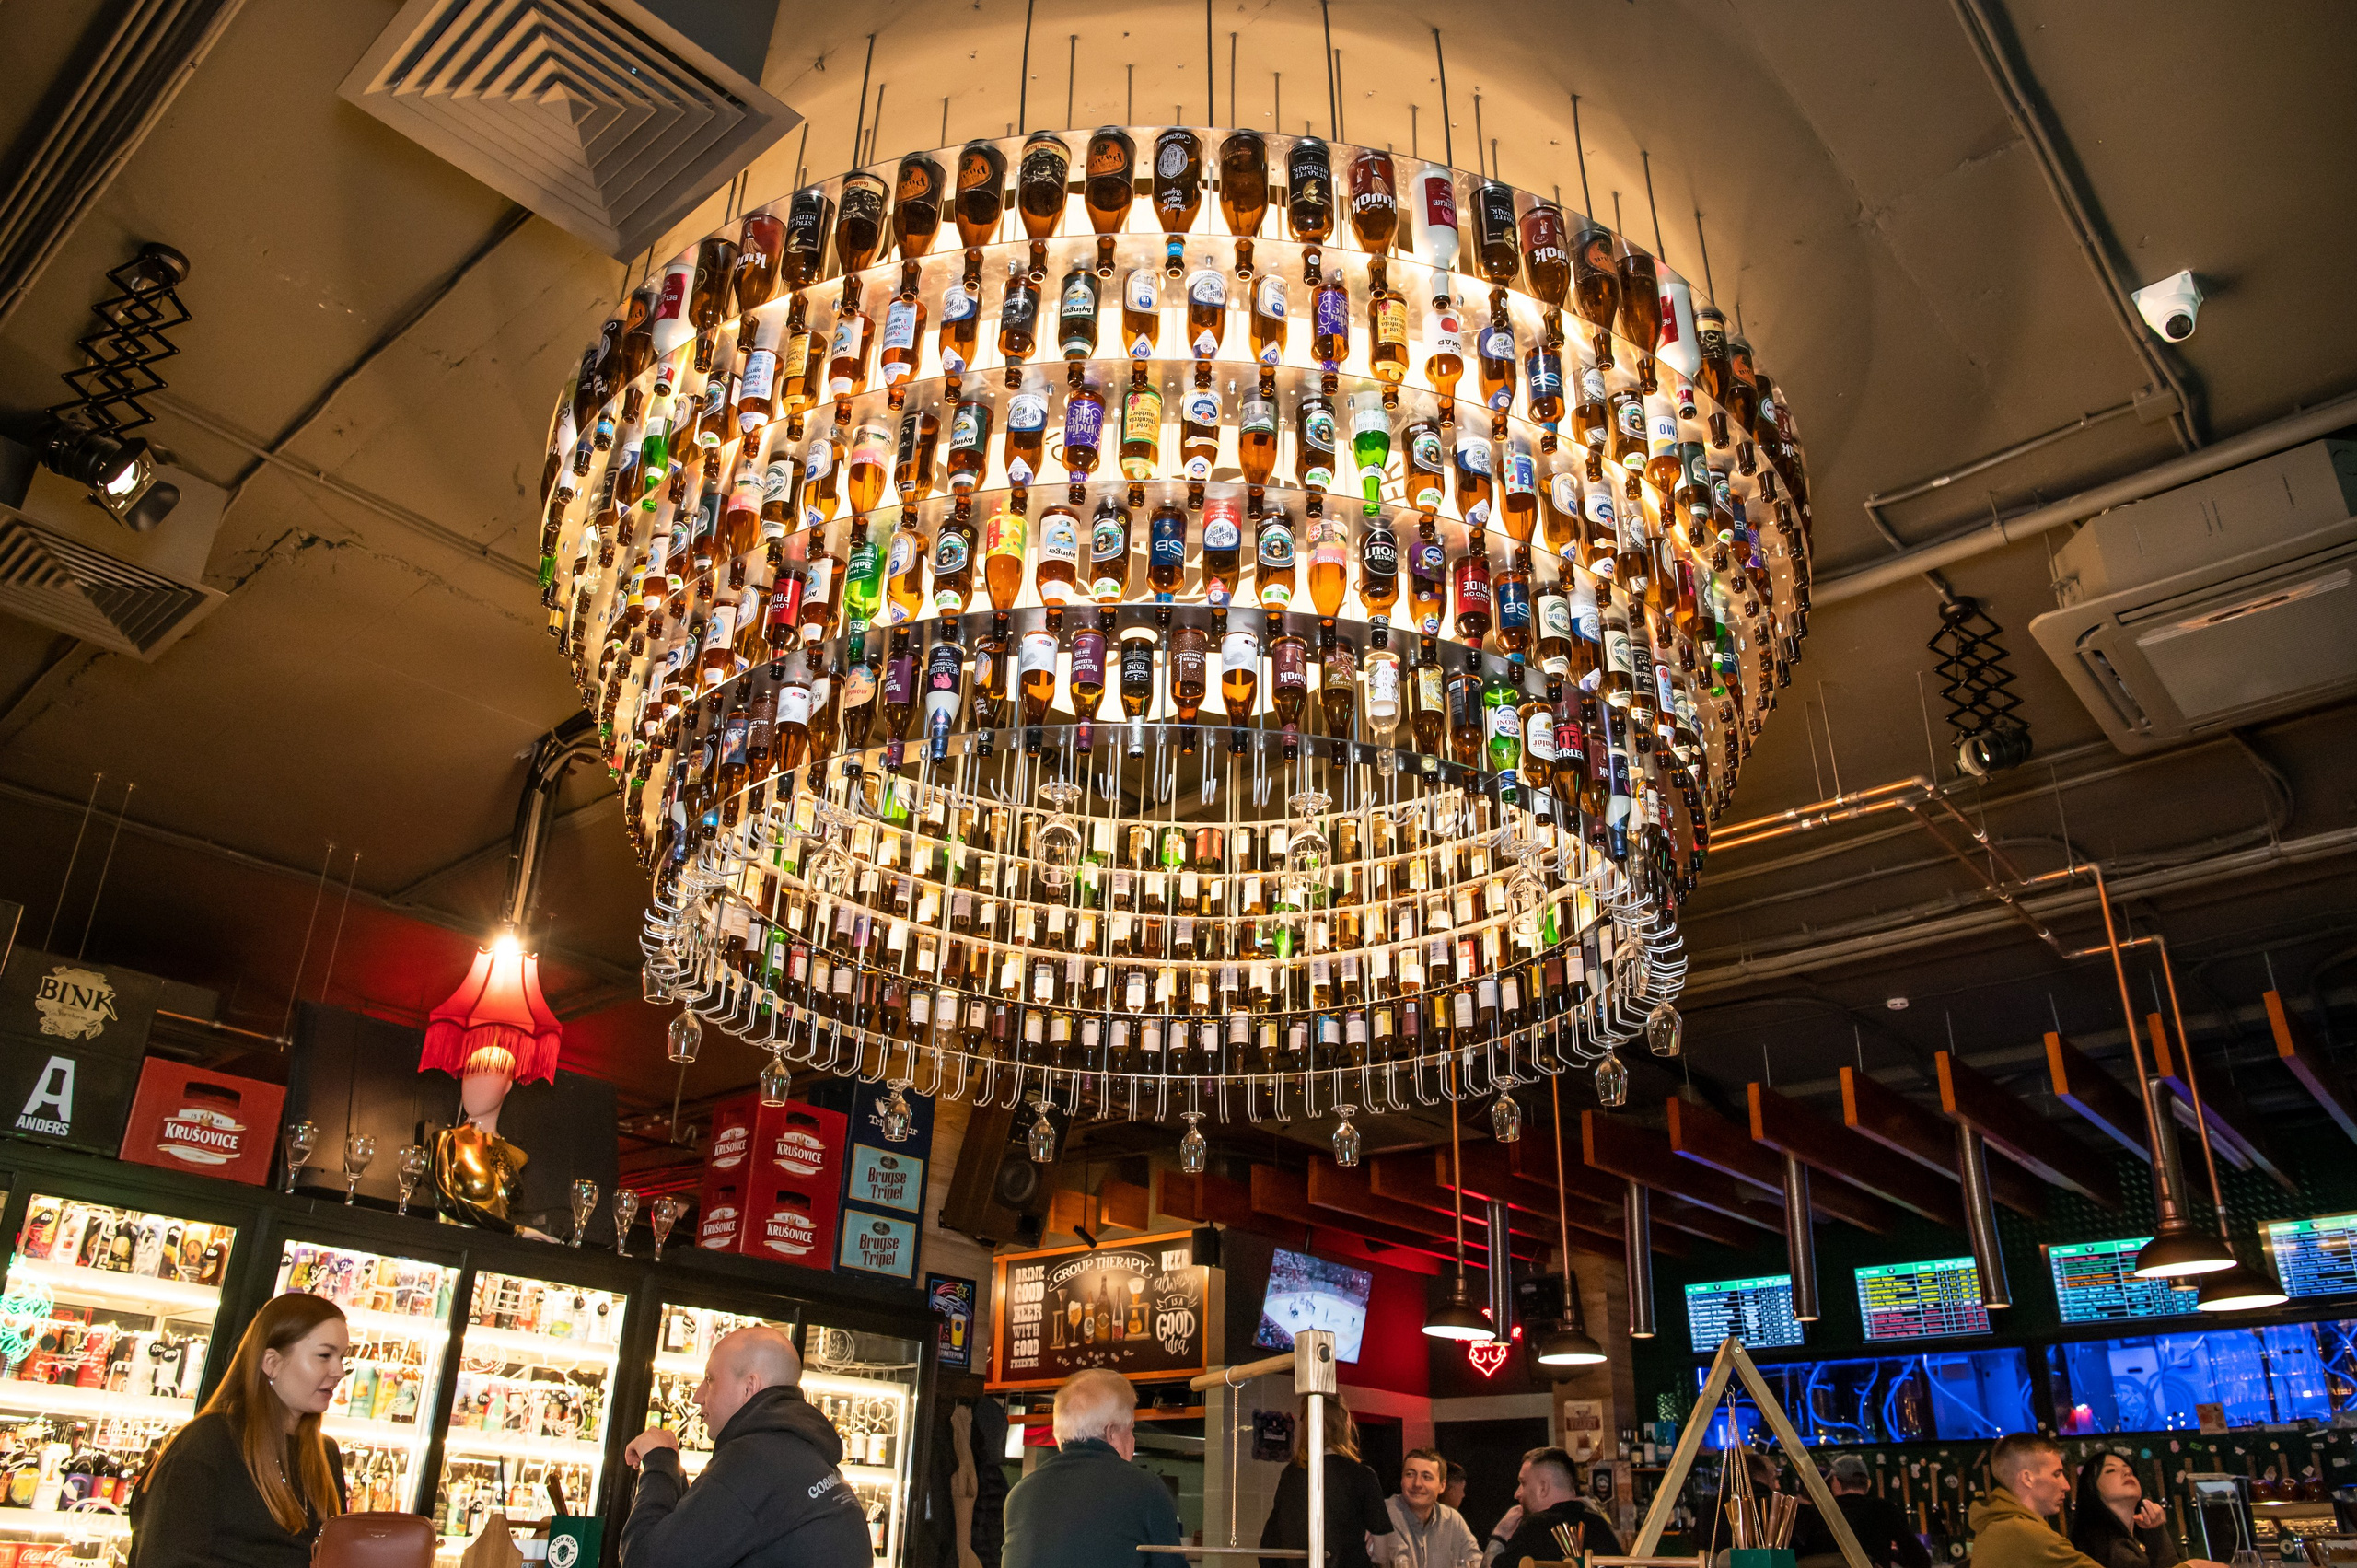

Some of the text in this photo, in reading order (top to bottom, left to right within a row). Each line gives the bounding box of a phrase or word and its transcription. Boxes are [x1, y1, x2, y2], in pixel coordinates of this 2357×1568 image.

[1292, 165, 1329, 175] HENDRIK
[1295, 171, 1328, 180] STRAFFE
[1062, 306, 1092, 315] Ayinger
[950, 437, 974, 447] Ayinge
[1047, 548, 1076, 560] Ayinger
[1316, 557, 1344, 565] SUNRISE
[1364, 546, 1398, 561] STOUT
[1173, 652, 1206, 661] ELANCHOLY
[1126, 663, 1146, 671] FARO
[36, 977, 117, 1019] BINK
[16, 1114, 71, 1137] ANDERS
[165, 1121, 239, 1149] KRUŠOVICE
[714, 1139, 747, 1156] KRUŠOVICE
[776, 1142, 822, 1164] KRUŠOVICE
[867, 1167, 907, 1187] Brugse
[871, 1184, 904, 1202] Tripel
[702, 1220, 736, 1237] KRUŠOVICE
[766, 1223, 813, 1243] KRUŠOVICE
[859, 1233, 900, 1253] Brugse
[862, 1250, 896, 1268] Tripel
[1160, 1249, 1190, 1272] BEER
[1015, 1266, 1045, 1283] DRINK
[1053, 1256, 1151, 1283] GROUP THERAPY
[1014, 1282, 1045, 1303] GOOD
[1013, 1303, 1043, 1323] BEER
[1013, 1322, 1040, 1339] WITH
[1156, 1310, 1196, 1342] GOOD
[1013, 1339, 1039, 1357] GOOD
[1164, 1336, 1189, 1355] idea
